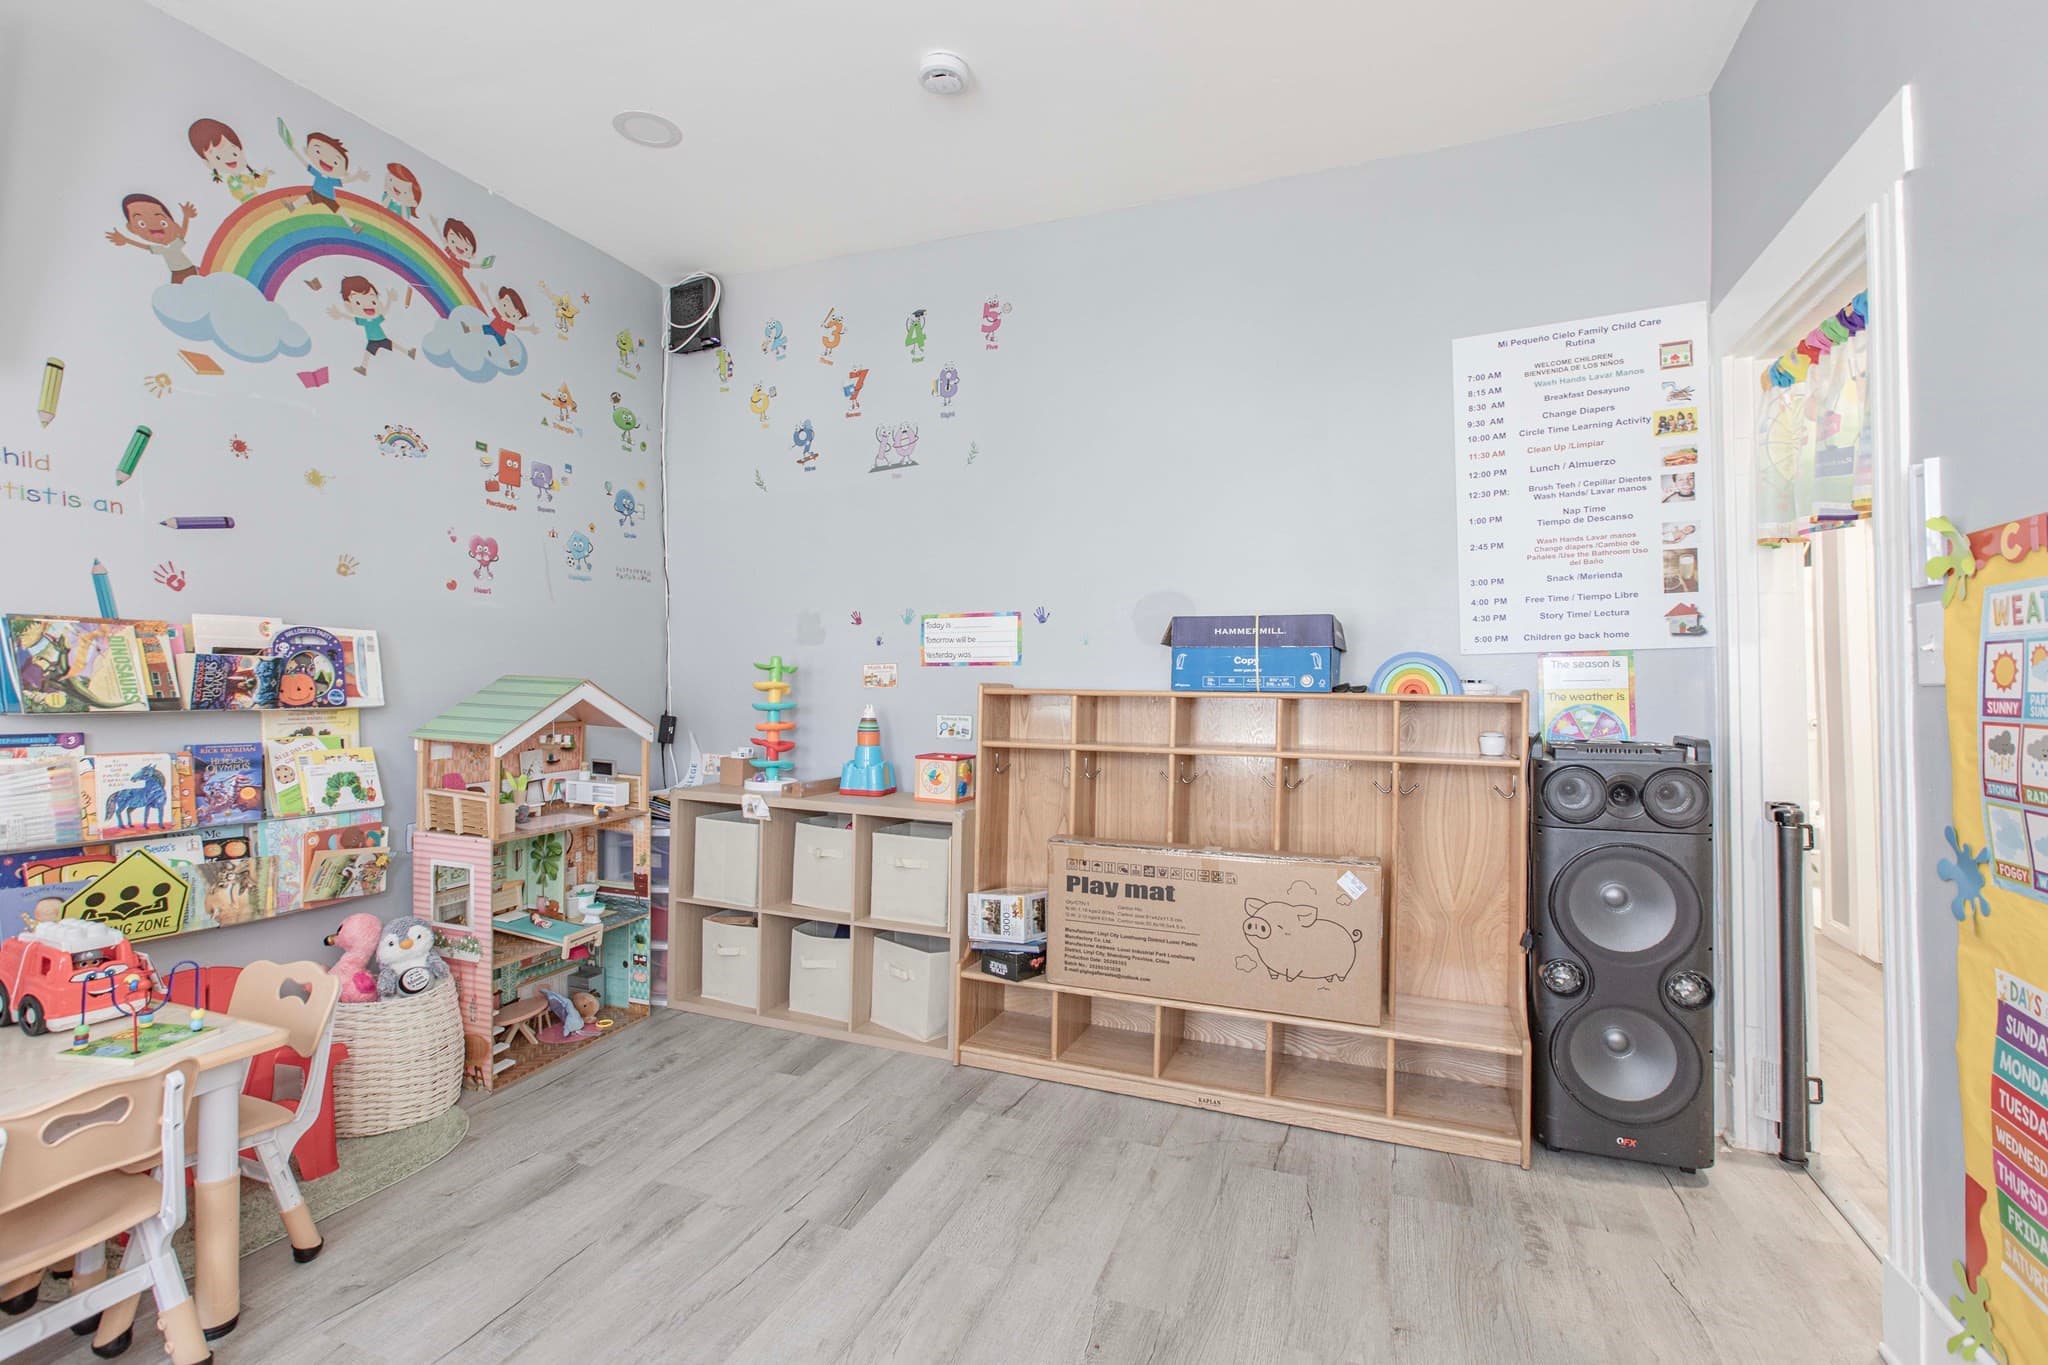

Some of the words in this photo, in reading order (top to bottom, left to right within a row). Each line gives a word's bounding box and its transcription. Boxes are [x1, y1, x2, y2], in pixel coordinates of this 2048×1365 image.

[822, 321, 843, 349] 3
[905, 322, 927, 348] 4
[1498, 340, 1508, 349] Mi
[1510, 335, 1549, 348] Pequeño
[1552, 330, 1576, 342] Cielo
[1578, 326, 1608, 339] Family
[1611, 321, 1636, 332] Child
[1640, 318, 1662, 328] Care
[1565, 337, 1595, 348] Rutina
[1534, 358, 1572, 368] WELCOME
[1574, 353, 1613, 364] CHILDREN
[1468, 374, 1486, 382] 7:00
[1488, 372, 1502, 380] AM
[1524, 366, 1571, 378] BIENVENIDA
[850, 369, 869, 400] 7
[1534, 378, 1557, 388] Wash
[1559, 374, 1588, 384] Hands
[1468, 388, 1486, 397] 8:15
[1488, 387, 1502, 395] AM
[1544, 391, 1584, 402] Breakfast
[1587, 384, 1630, 398] Desayuno
[1468, 403, 1486, 412] 8:30
[1491, 401, 1505, 409] AM
[1542, 409, 1577, 421] Change
[1580, 404, 1616, 417] Diapers
[1467, 419, 1485, 428] 9:30
[1490, 417, 1504, 426] AM
[1519, 426, 1545, 437] Circle
[1548, 424, 1569, 434] Time
[1572, 419, 1613, 432] Learning
[1616, 416, 1652, 427] Activity
[1468, 434, 1491, 443] 10:00
[1492, 432, 1506, 440] AM
[1527, 444, 1552, 454] Clean
[1554, 442, 1566, 453] Up
[0, 447, 50, 472] hild
[1469, 451, 1490, 461] 11:30
[1492, 450, 1505, 458] AM
[1530, 463, 1560, 474] Lunch
[1569, 458, 1616, 468] Almuerzo
[1469, 470, 1491, 479] 12:00
[1493, 468, 1507, 477] PM
[1528, 482, 1554, 492] Brush
[1583, 477, 1616, 489] Cepillar
[1619, 474, 1652, 485] Dientes
[0, 481, 58, 504] tist
[62, 491, 82, 508] is
[94, 499, 124, 514] an
[1469, 491, 1491, 499] 12:30
[1533, 491, 1556, 501] Wash
[1559, 489, 1588, 498] Hands/
[1590, 486, 1616, 496] Lavar
[1618, 484, 1647, 493] manos
[1562, 507, 1581, 516] Nap
[1584, 505, 1606, 514] Time
[1537, 517, 1571, 527] Tiempo
[1573, 515, 1585, 524] de
[1587, 512, 1634, 523] Descanso
[1470, 543, 1489, 551] 2:45
[1490, 542, 1504, 550] PM
[1470, 578, 1488, 587] 3:00
[1490, 577, 1504, 585] PM
[1546, 573, 1574, 583] Snack
[1577, 570, 1623, 581] /Merienda
[1471, 598, 1489, 606] 4:00
[1494, 597, 1507, 605] PM
[1525, 595, 1545, 604] Free
[1548, 594, 1570, 603] Time
[1577, 591, 1612, 602] Tiempo
[1614, 590, 1639, 599] Libre
[1473, 614, 1490, 623] 4:30
[1493, 613, 1506, 622] PM
[1540, 611, 1565, 622] Story
[1567, 610, 1591, 619] Time/
[1594, 608, 1630, 618] Lectura
[926, 622, 944, 630] Today
[926, 636, 954, 644] Tomorrow
[1475, 635, 1493, 644] 5:00
[1495, 634, 1508, 642] PM
[1524, 632, 1562, 642] Children
[1564, 633, 1576, 642] go
[1579, 631, 1601, 640] back
[1603, 630, 1630, 639] home
[926, 651, 956, 660] Yesterday
[110, 635, 142, 704] DINOSAURS
[1551, 660, 1570, 669] The
[1572, 660, 1610, 668] season
[1612, 658, 1620, 668] is
[1549, 692, 1566, 702] The
[1569, 692, 1614, 702] weather
[1616, 692, 1625, 701] is
[1987, 702, 2019, 715] SUNNY
[68, 736, 76, 744] 3
[205, 830, 221, 840] Me
[144, 842, 176, 853] Seuss's
[2000, 863, 2028, 881] FOGGY
[1066, 875, 1119, 898] Play
[1124, 883, 1176, 902] mat
[136, 916, 171, 932] ZONE
[1002, 912, 1010, 936] 3000
[2010, 980, 2042, 1016] DAYS
[2006, 1014, 2048, 1057] SUNDA
[1999, 1088, 2048, 1140] TUESDA
